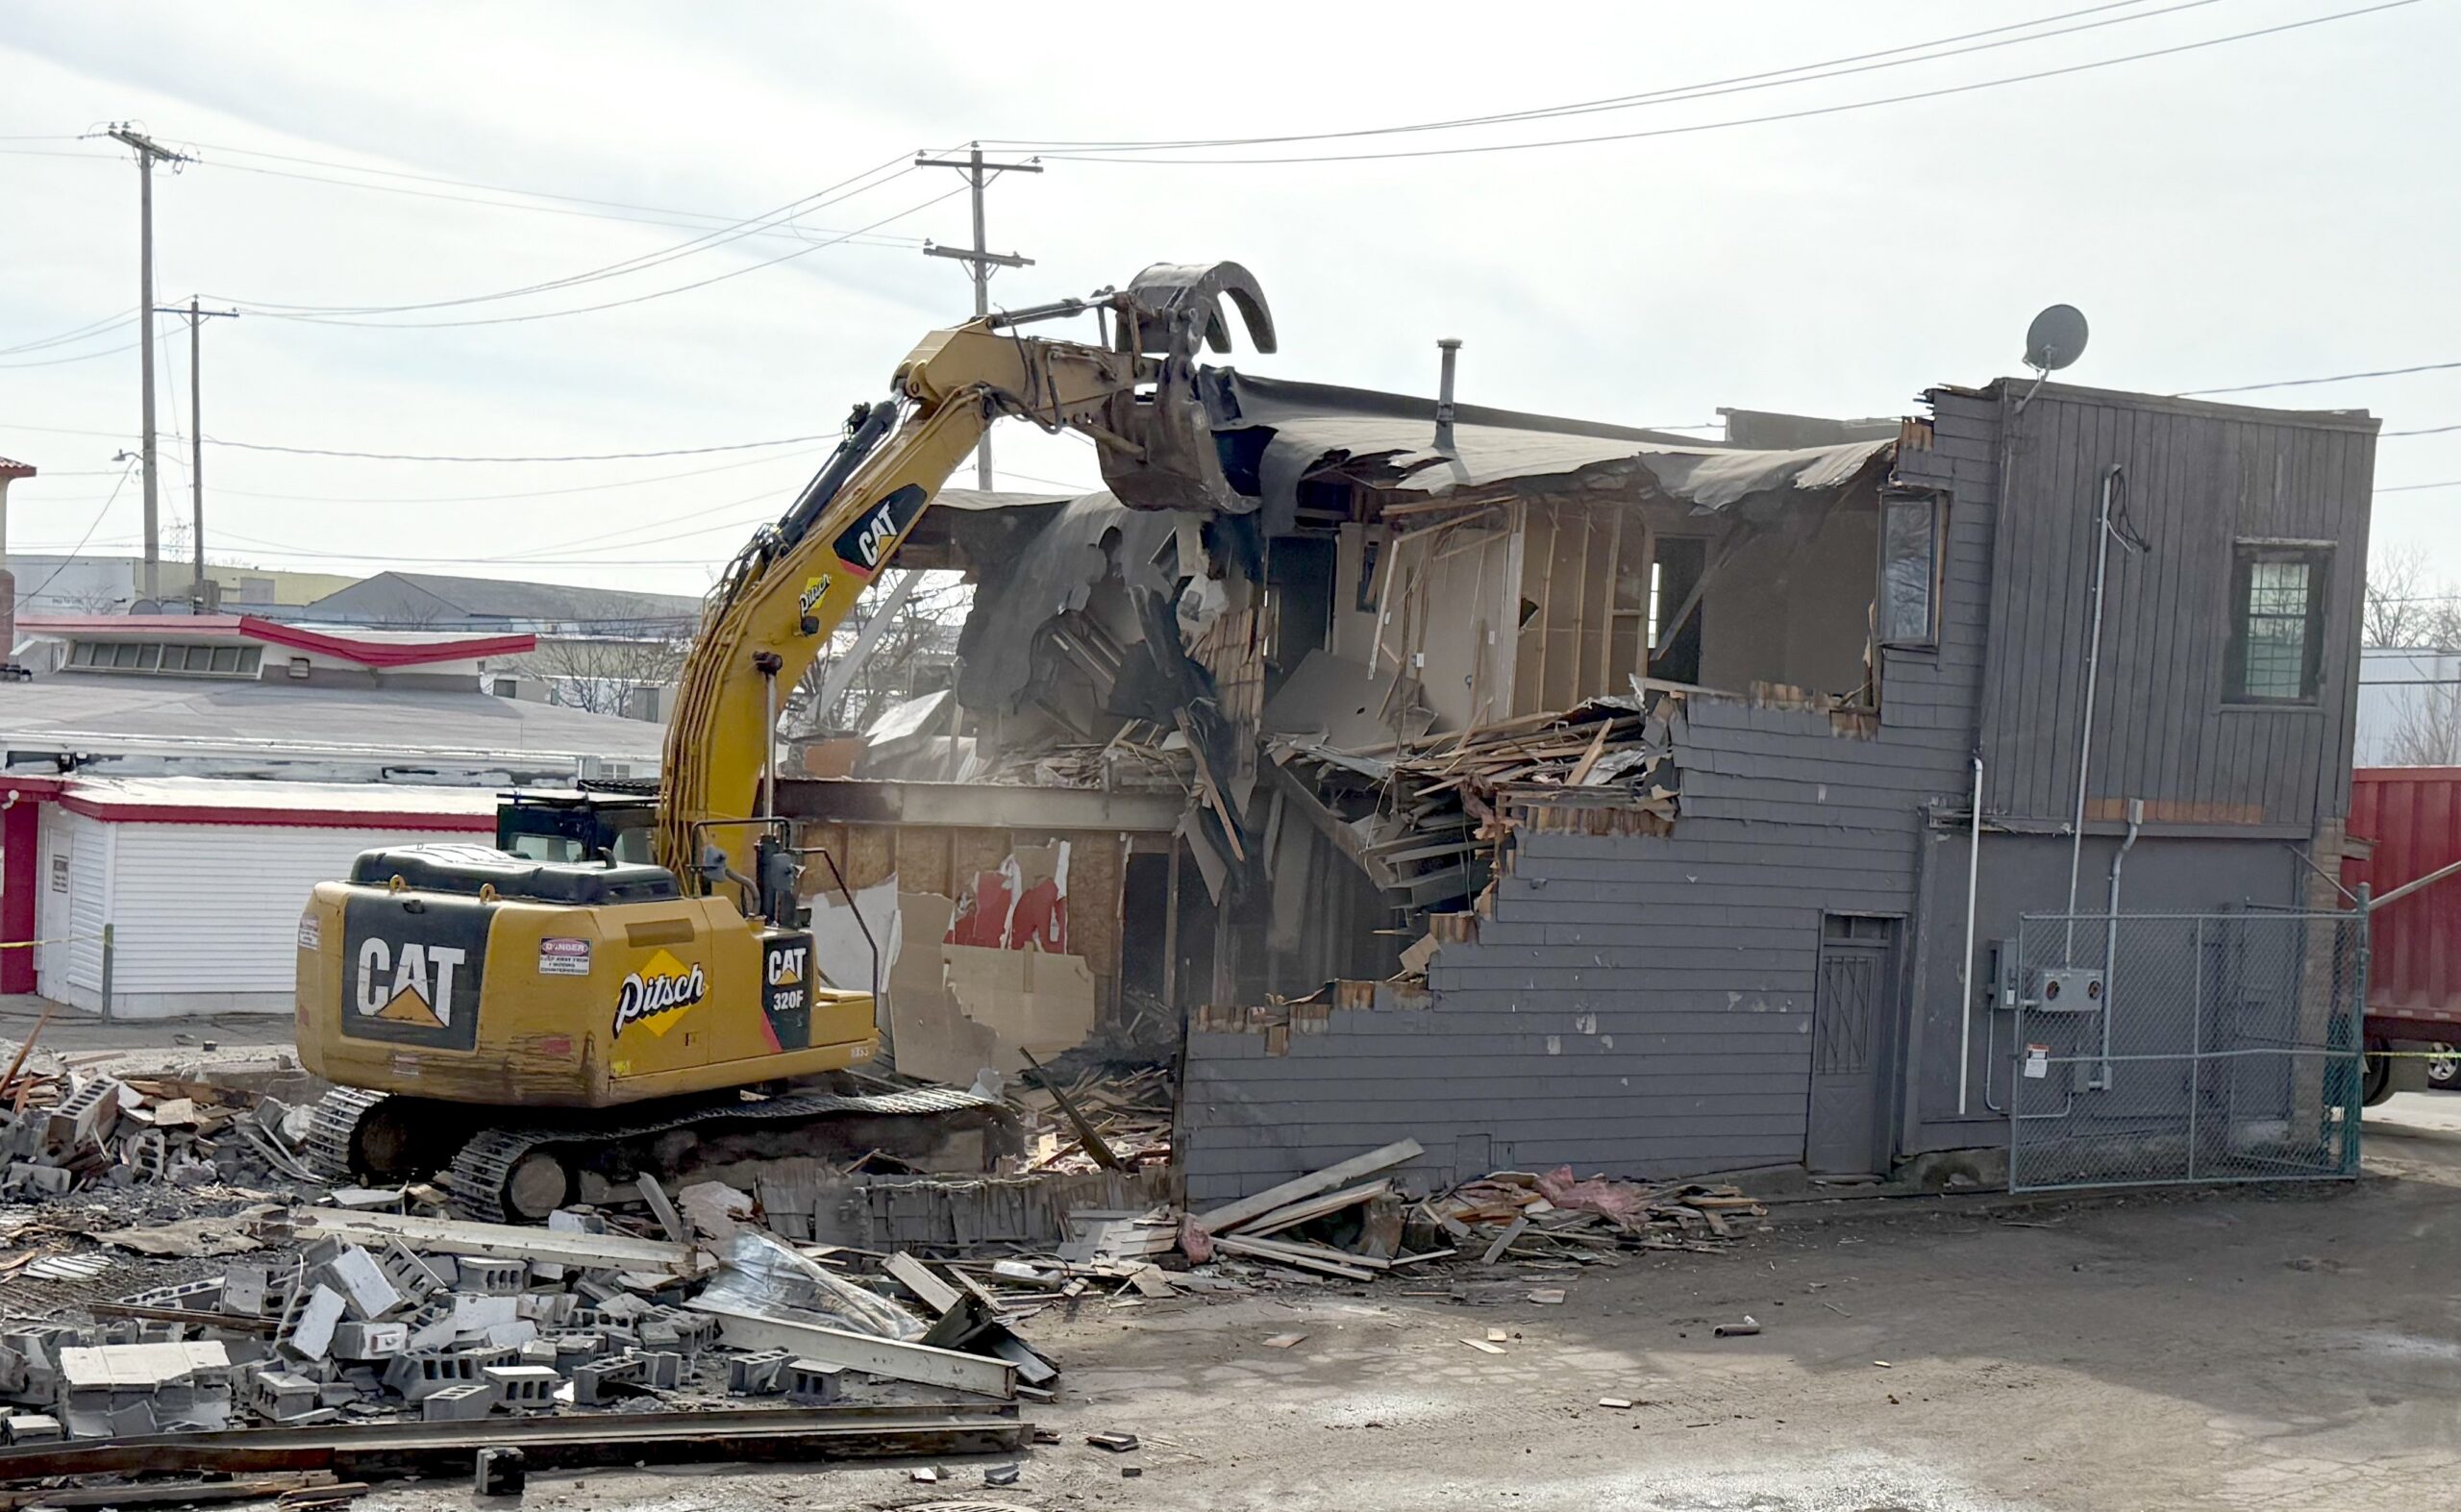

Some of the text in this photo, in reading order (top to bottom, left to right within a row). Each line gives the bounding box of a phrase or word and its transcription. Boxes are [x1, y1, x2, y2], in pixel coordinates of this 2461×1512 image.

[858, 501, 898, 567] CAT
[357, 937, 465, 1028] CAT
[613, 962, 704, 1038] Pitsch
[769, 948, 807, 986] CAT
[773, 990, 804, 1011] 320F
